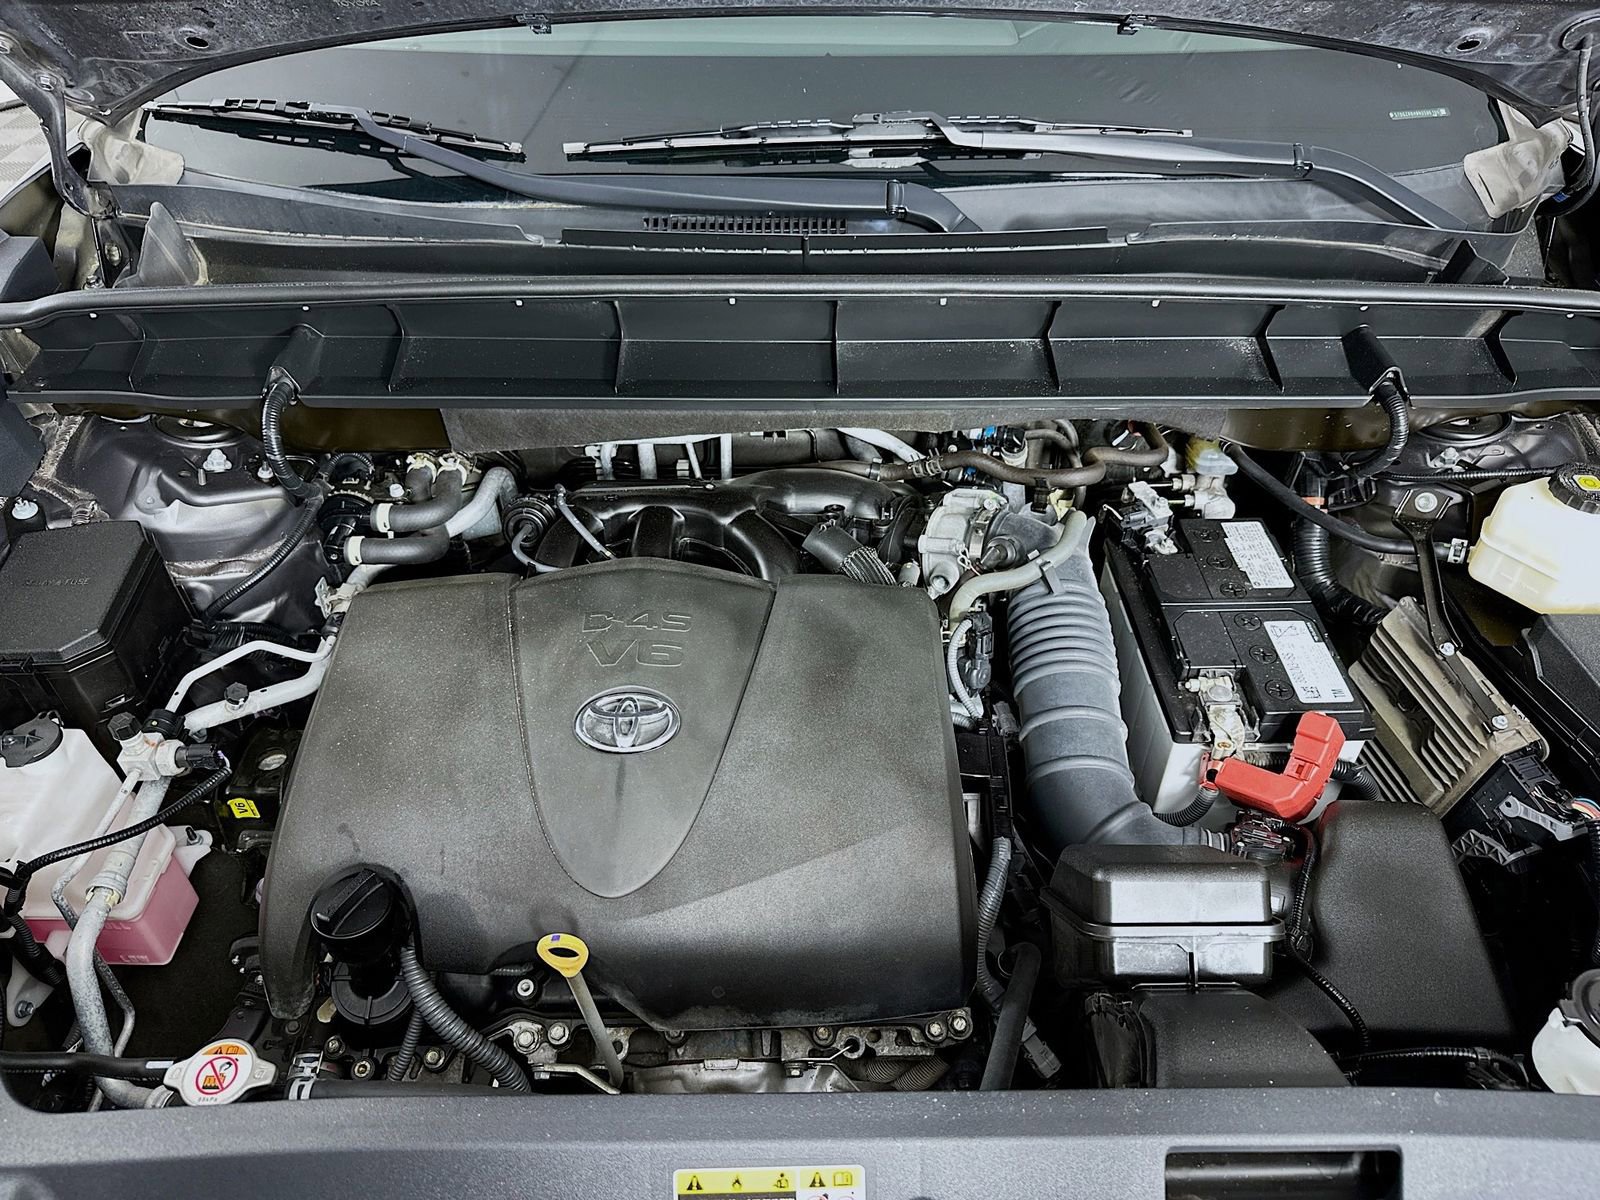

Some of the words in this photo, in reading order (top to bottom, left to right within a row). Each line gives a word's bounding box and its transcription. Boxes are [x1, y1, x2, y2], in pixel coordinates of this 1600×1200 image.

[582, 609, 692, 632] D-4S
[586, 638, 684, 667] V6
[235, 802, 249, 814] V6
